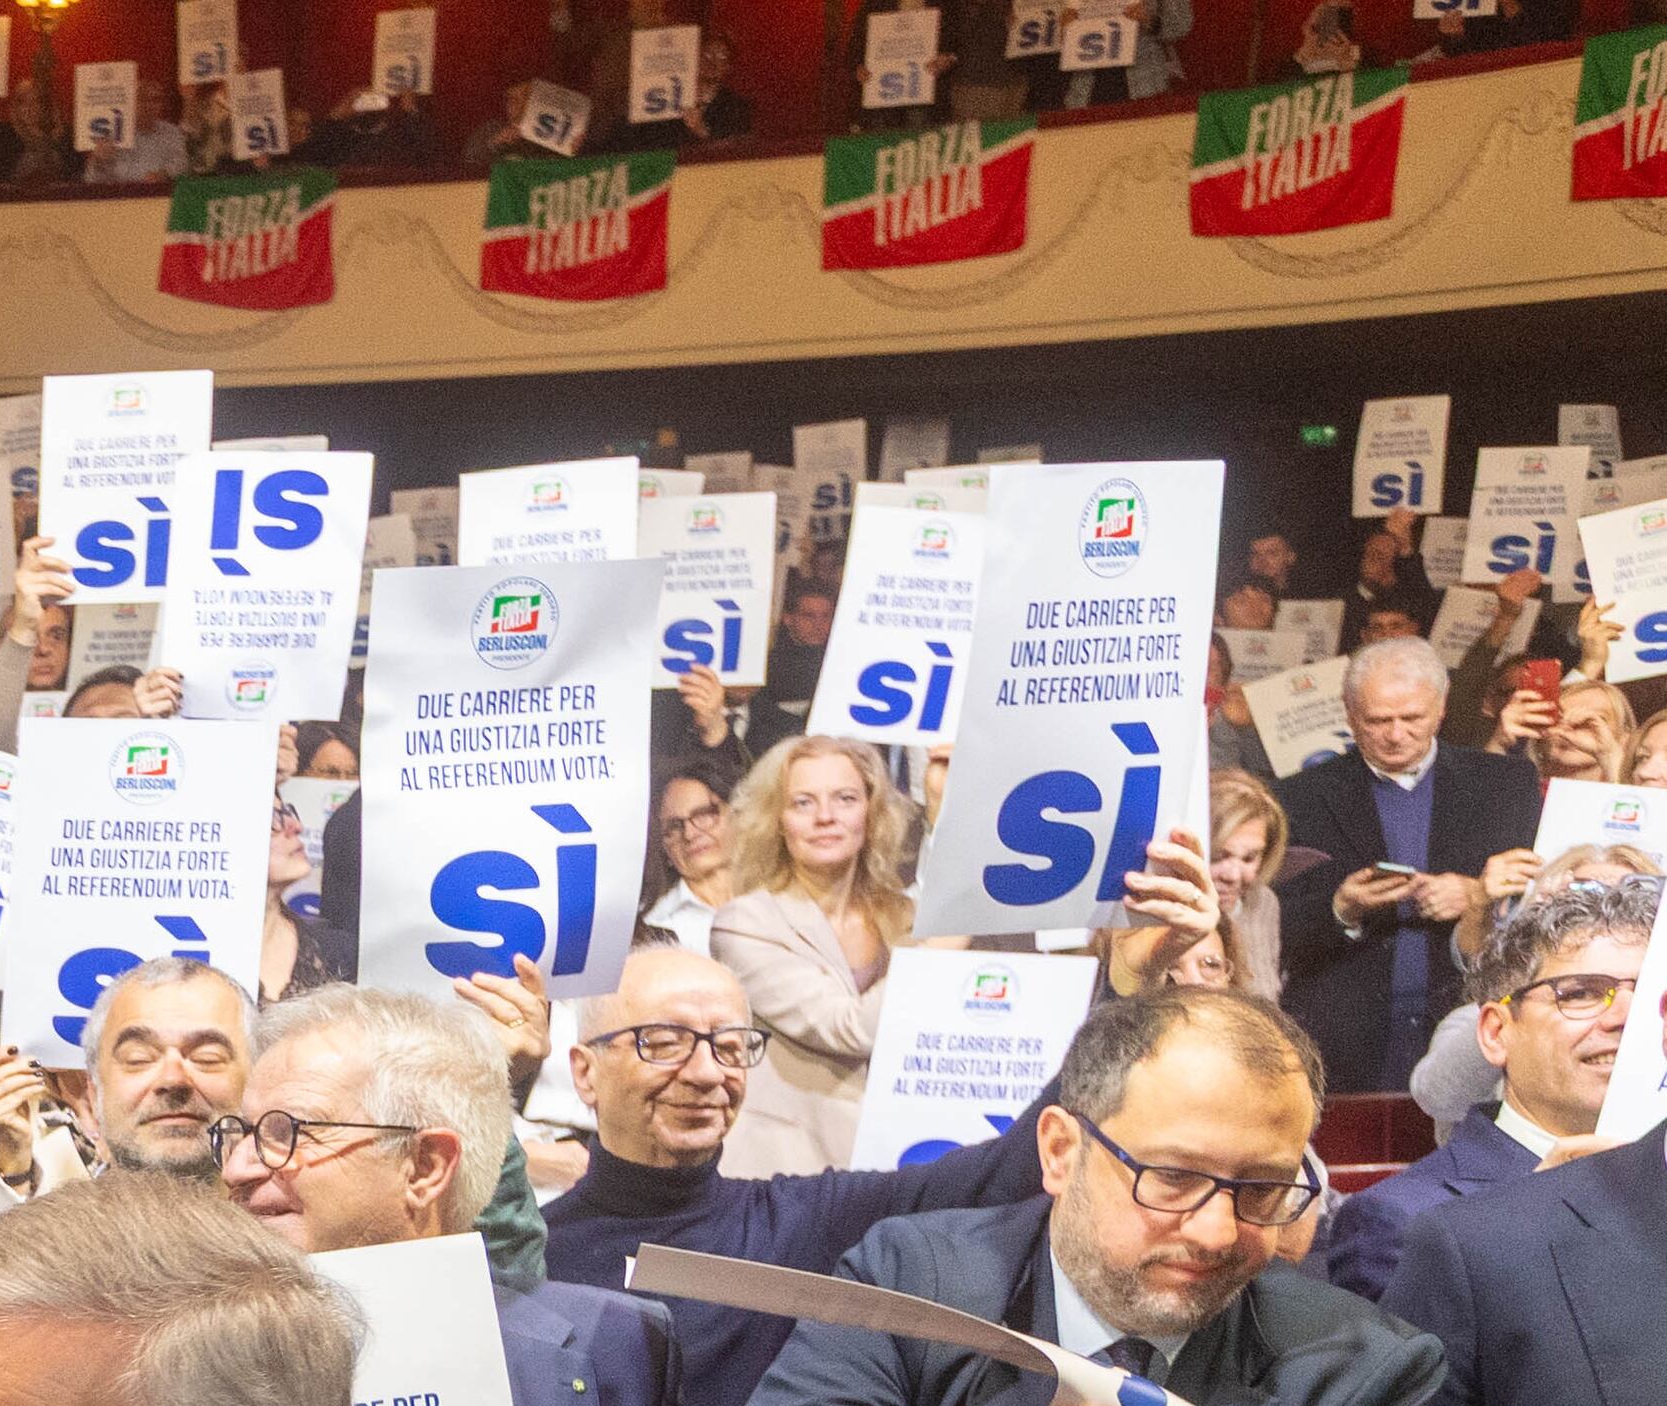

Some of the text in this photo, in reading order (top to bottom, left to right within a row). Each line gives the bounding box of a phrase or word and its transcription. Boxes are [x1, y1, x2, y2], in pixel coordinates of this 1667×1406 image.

[1249, 73, 1354, 155] FORZA
[875, 122, 981, 195] FORZA
[1242, 122, 1353, 209] ITALIA
[205, 185, 300, 242] FORZA
[528, 163, 629, 230] FORZA
[873, 165, 983, 247] ITALIA
[202, 224, 297, 281] ITALIA
[526, 210, 629, 275] ITALIA
[1026, 596, 1176, 629] DUE CARRIERE PER
[1011, 634, 1181, 668] UNA GIUSTIZIA FORTE
[418, 685, 595, 719] DUE CARRIERE PER
[996, 671, 1182, 706] AL REFERENDUM VOTA:
[406, 720, 605, 756] UNA GIUSTIZIA FORTE
[401, 755, 614, 790] AL REFERENDUM VOTA:
